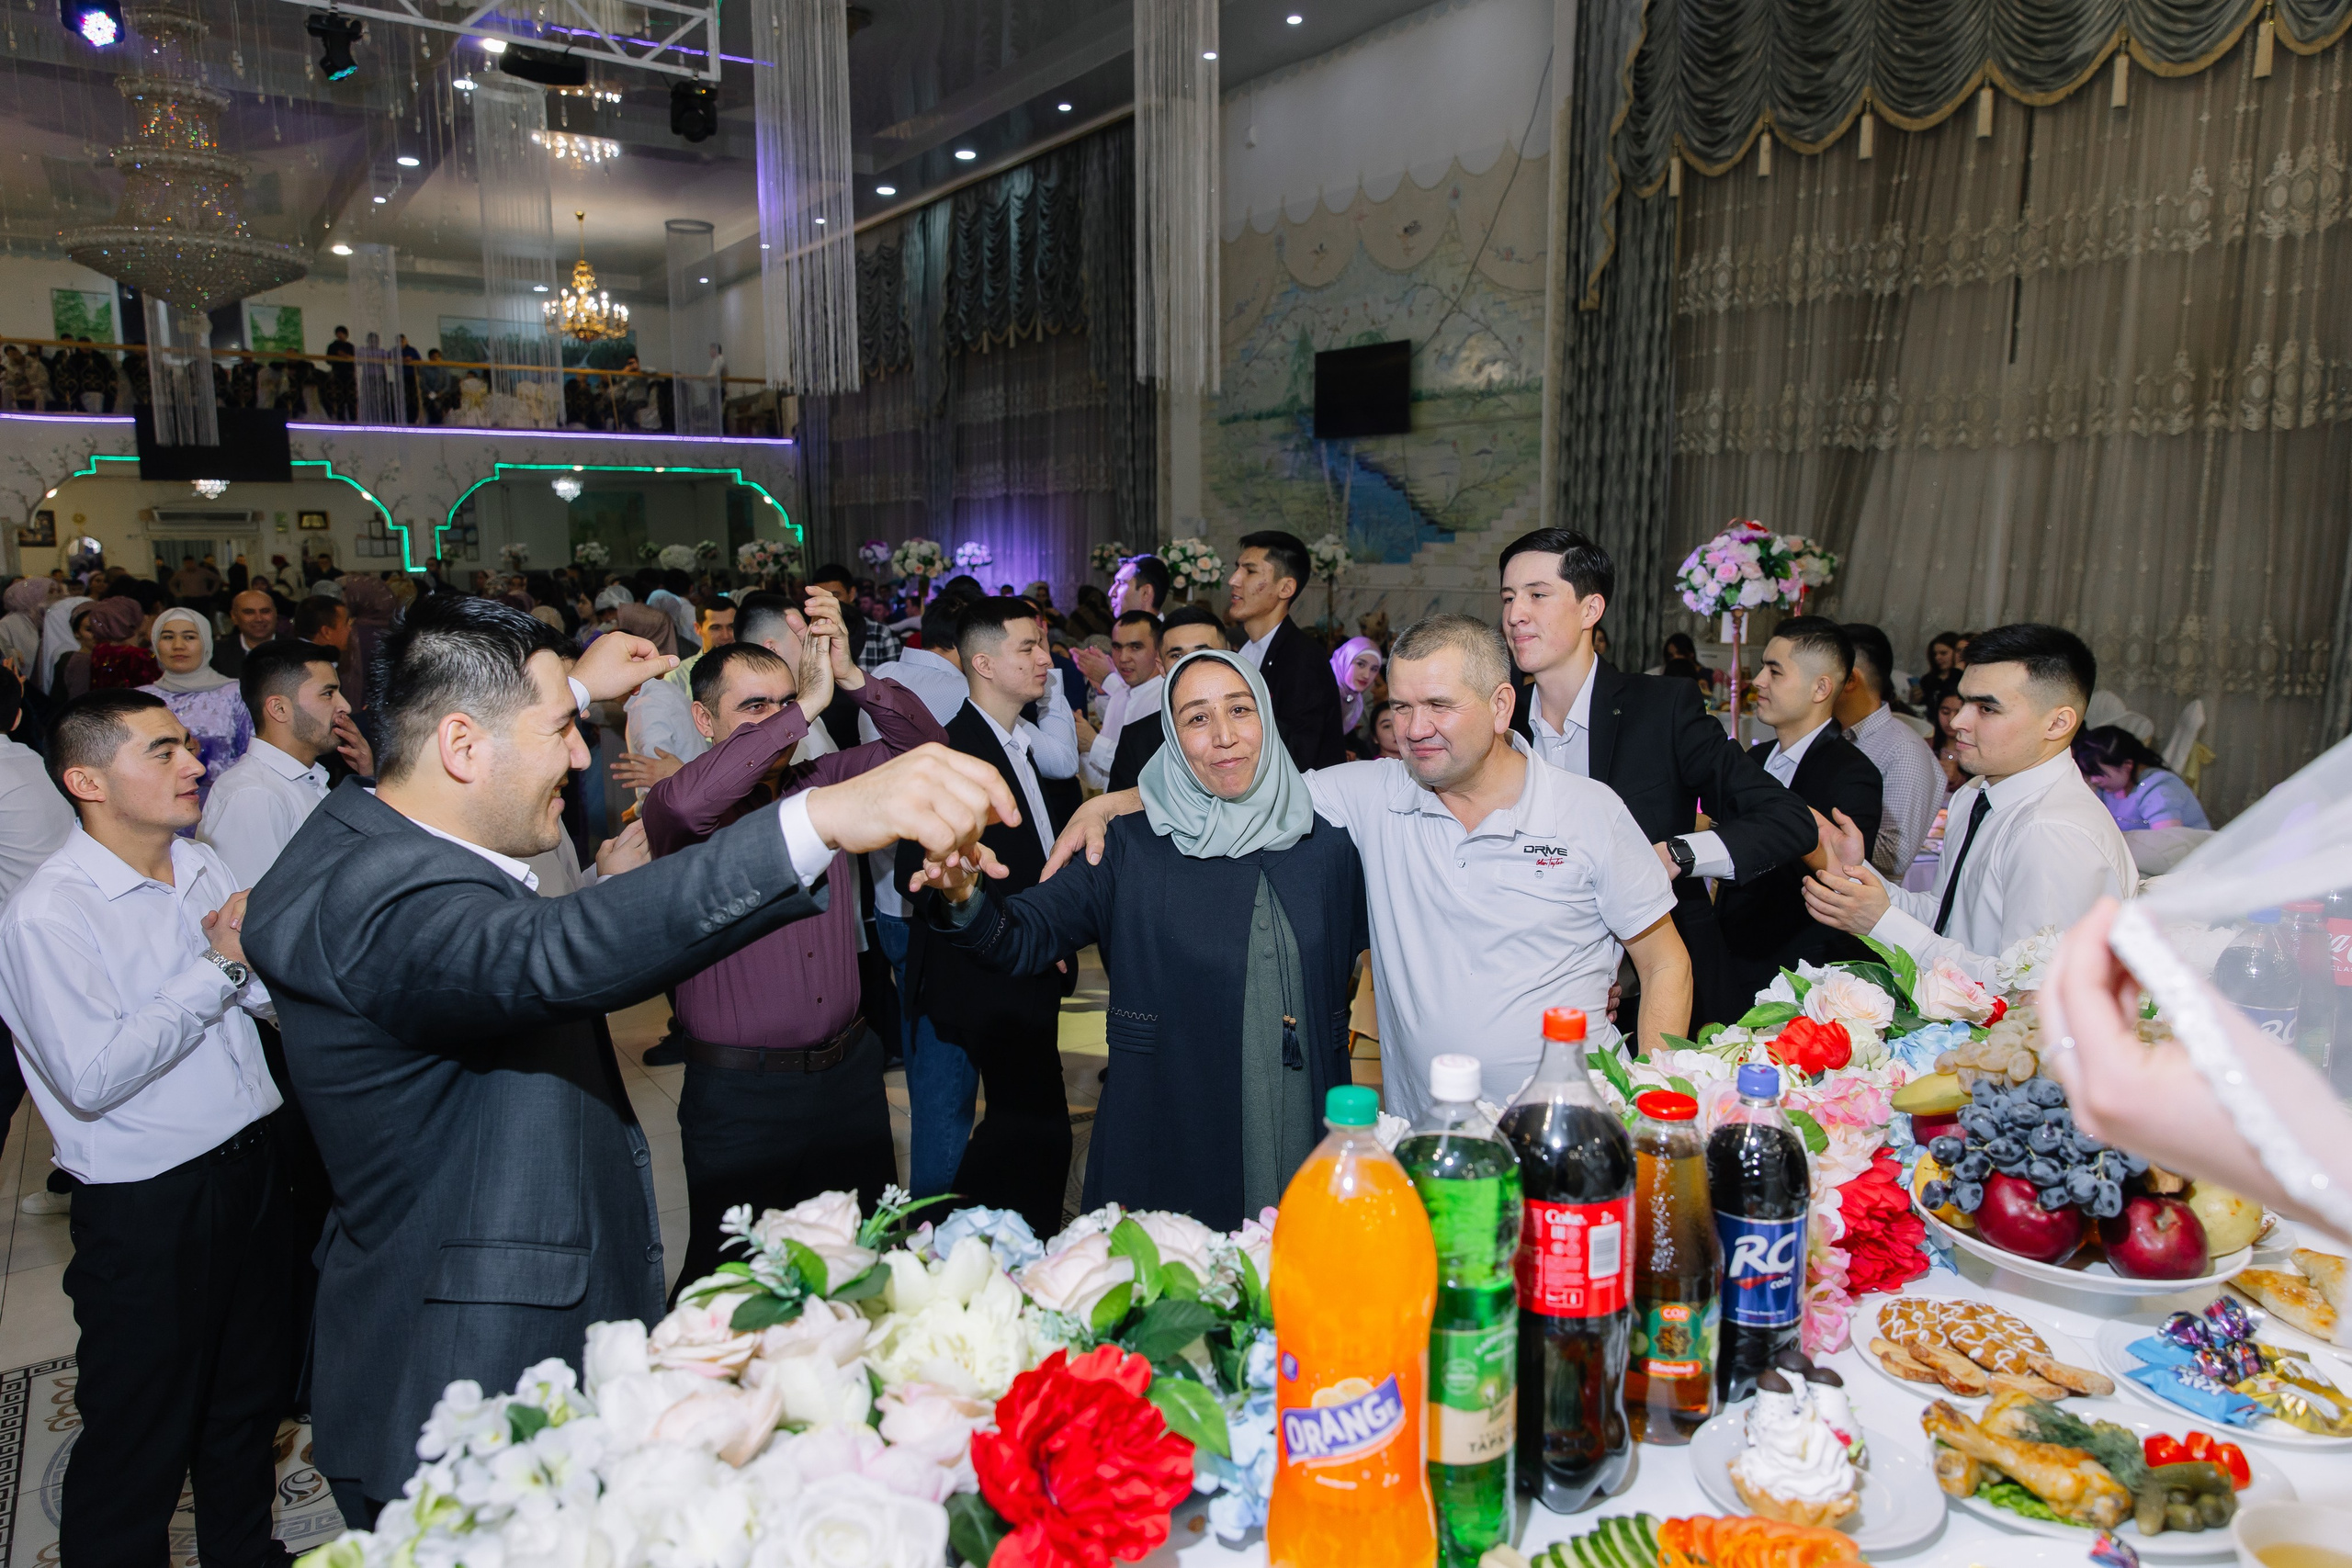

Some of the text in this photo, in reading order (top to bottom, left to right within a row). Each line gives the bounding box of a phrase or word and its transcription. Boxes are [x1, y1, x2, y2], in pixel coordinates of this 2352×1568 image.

[1523, 845, 1567, 856] DRIVE
[1729, 1231, 1797, 1278] RC
[1770, 1276, 1792, 1290] cola
